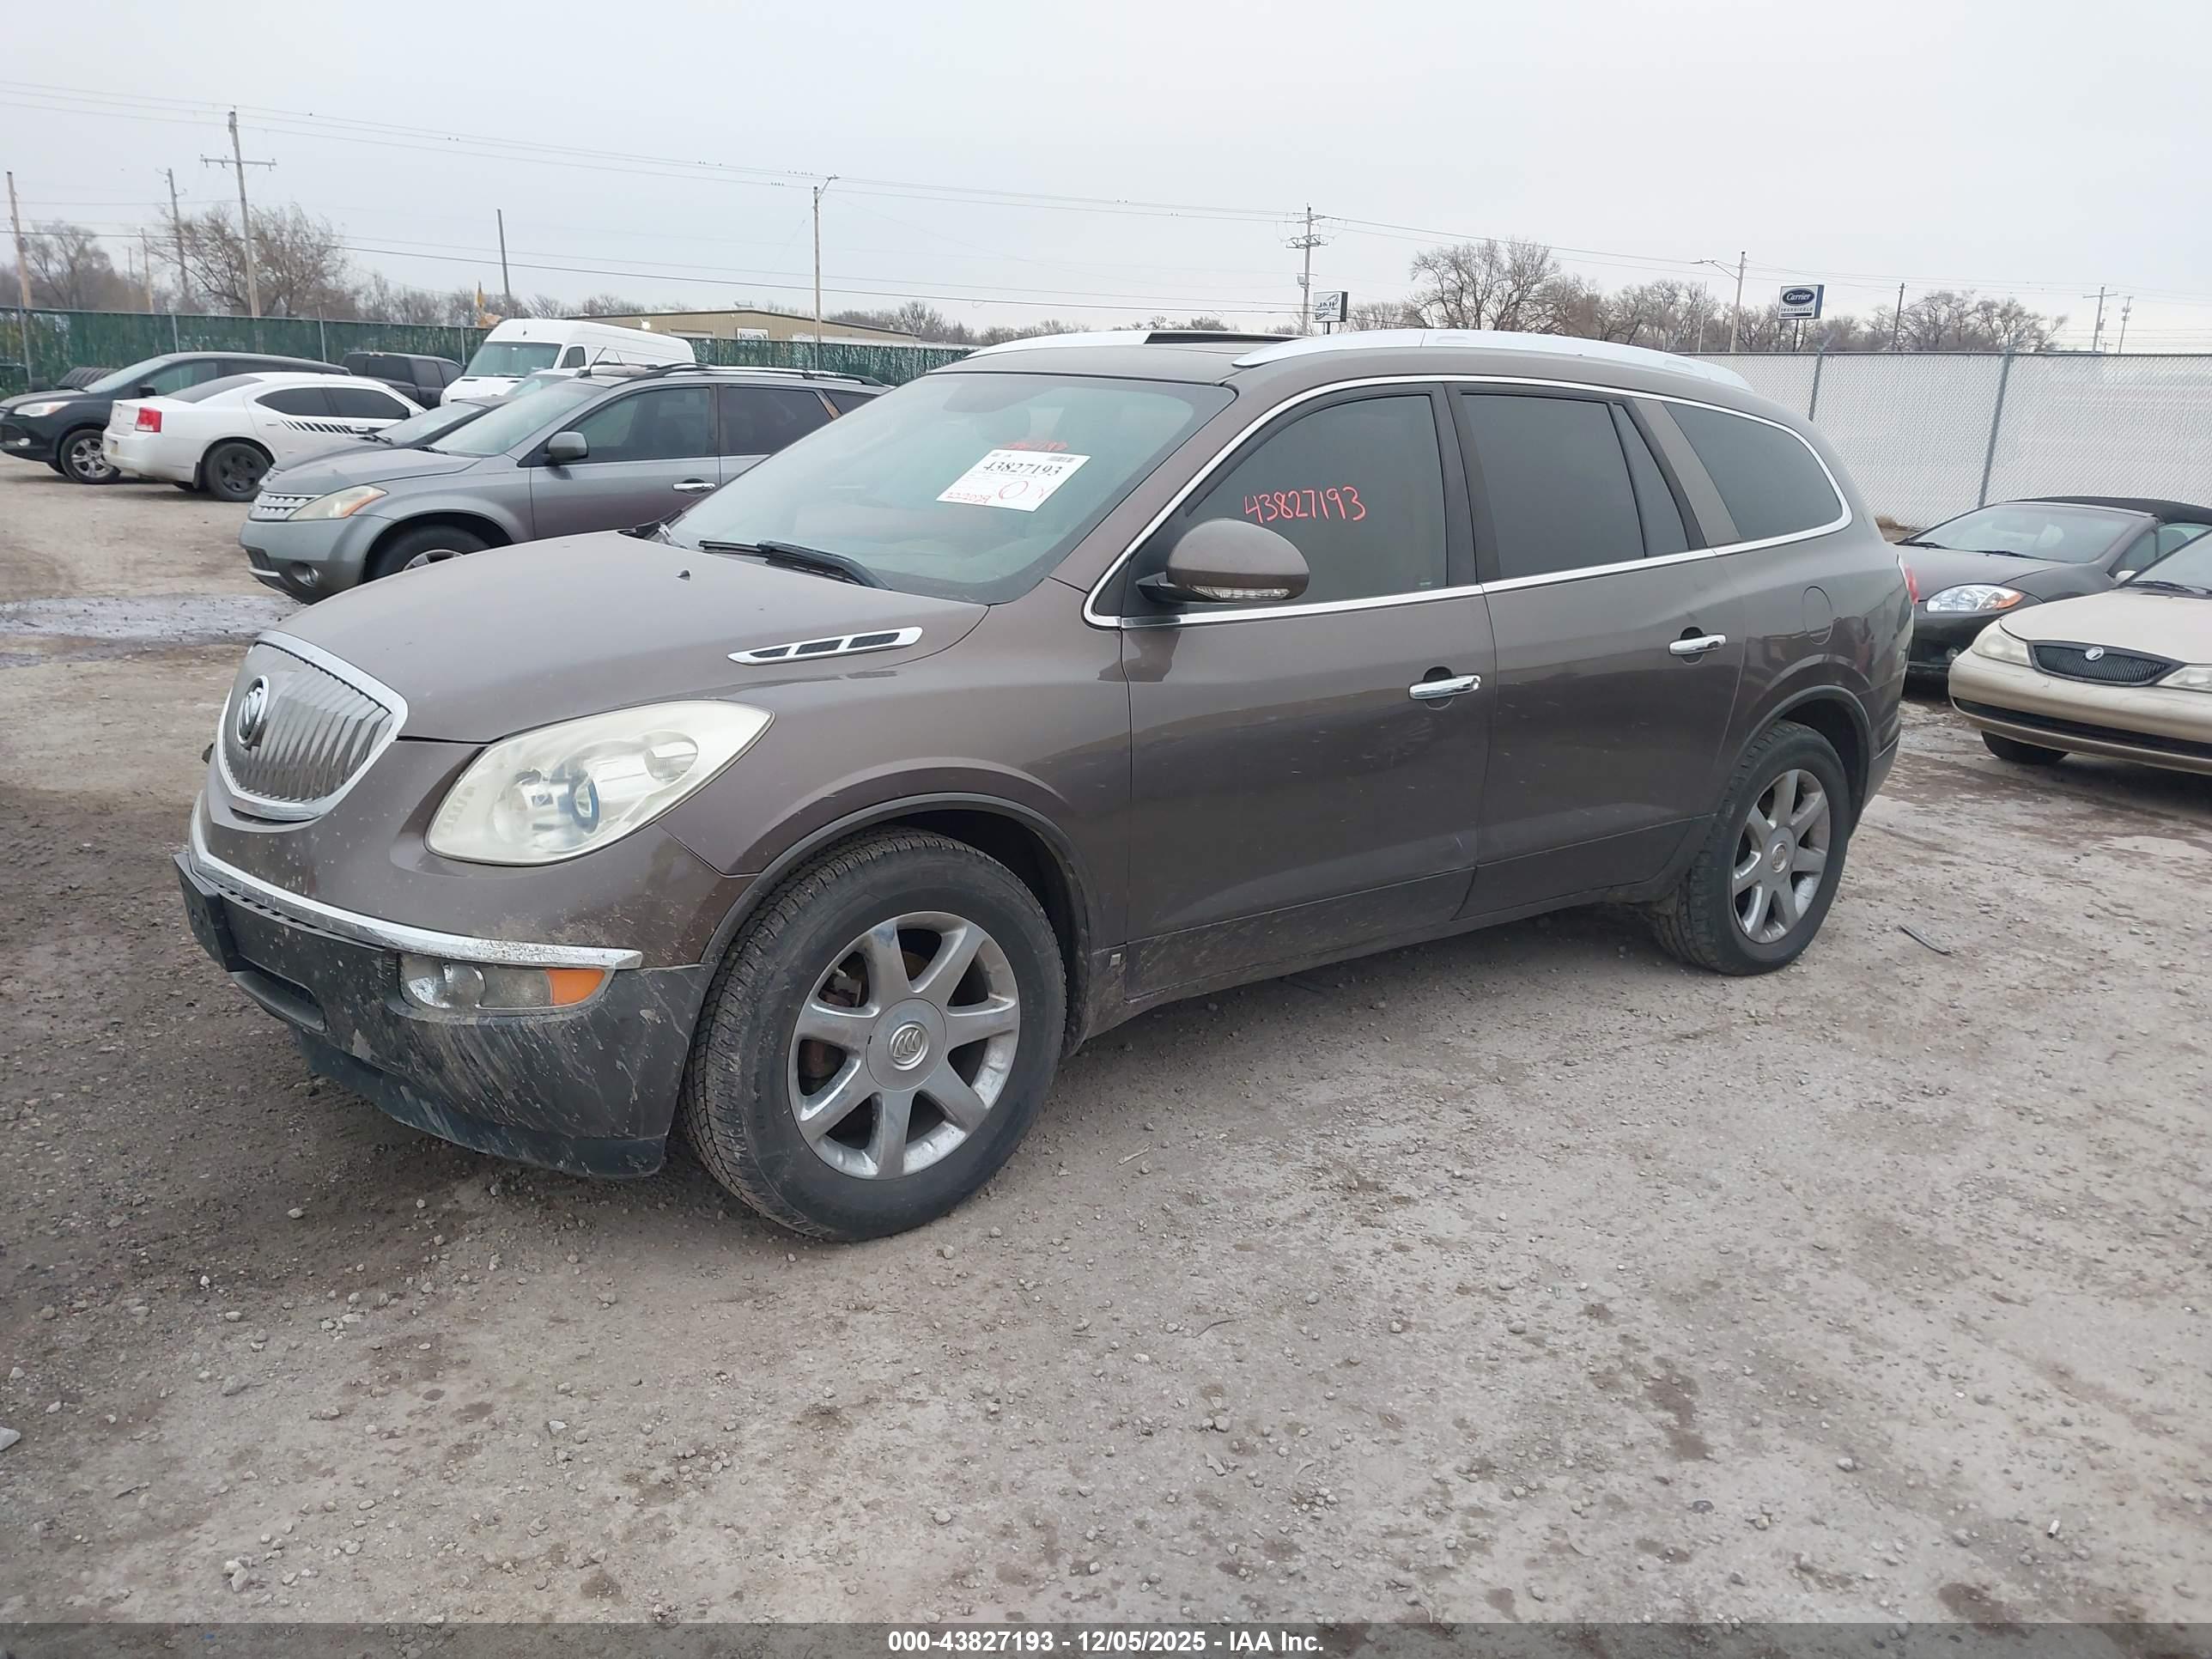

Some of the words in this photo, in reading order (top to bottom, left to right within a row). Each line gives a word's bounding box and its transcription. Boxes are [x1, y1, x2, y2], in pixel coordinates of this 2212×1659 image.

[1786, 292, 1811, 301] Carrier
[983, 460, 1063, 477] 43827193
[1243, 485, 1367, 524] 43827193
